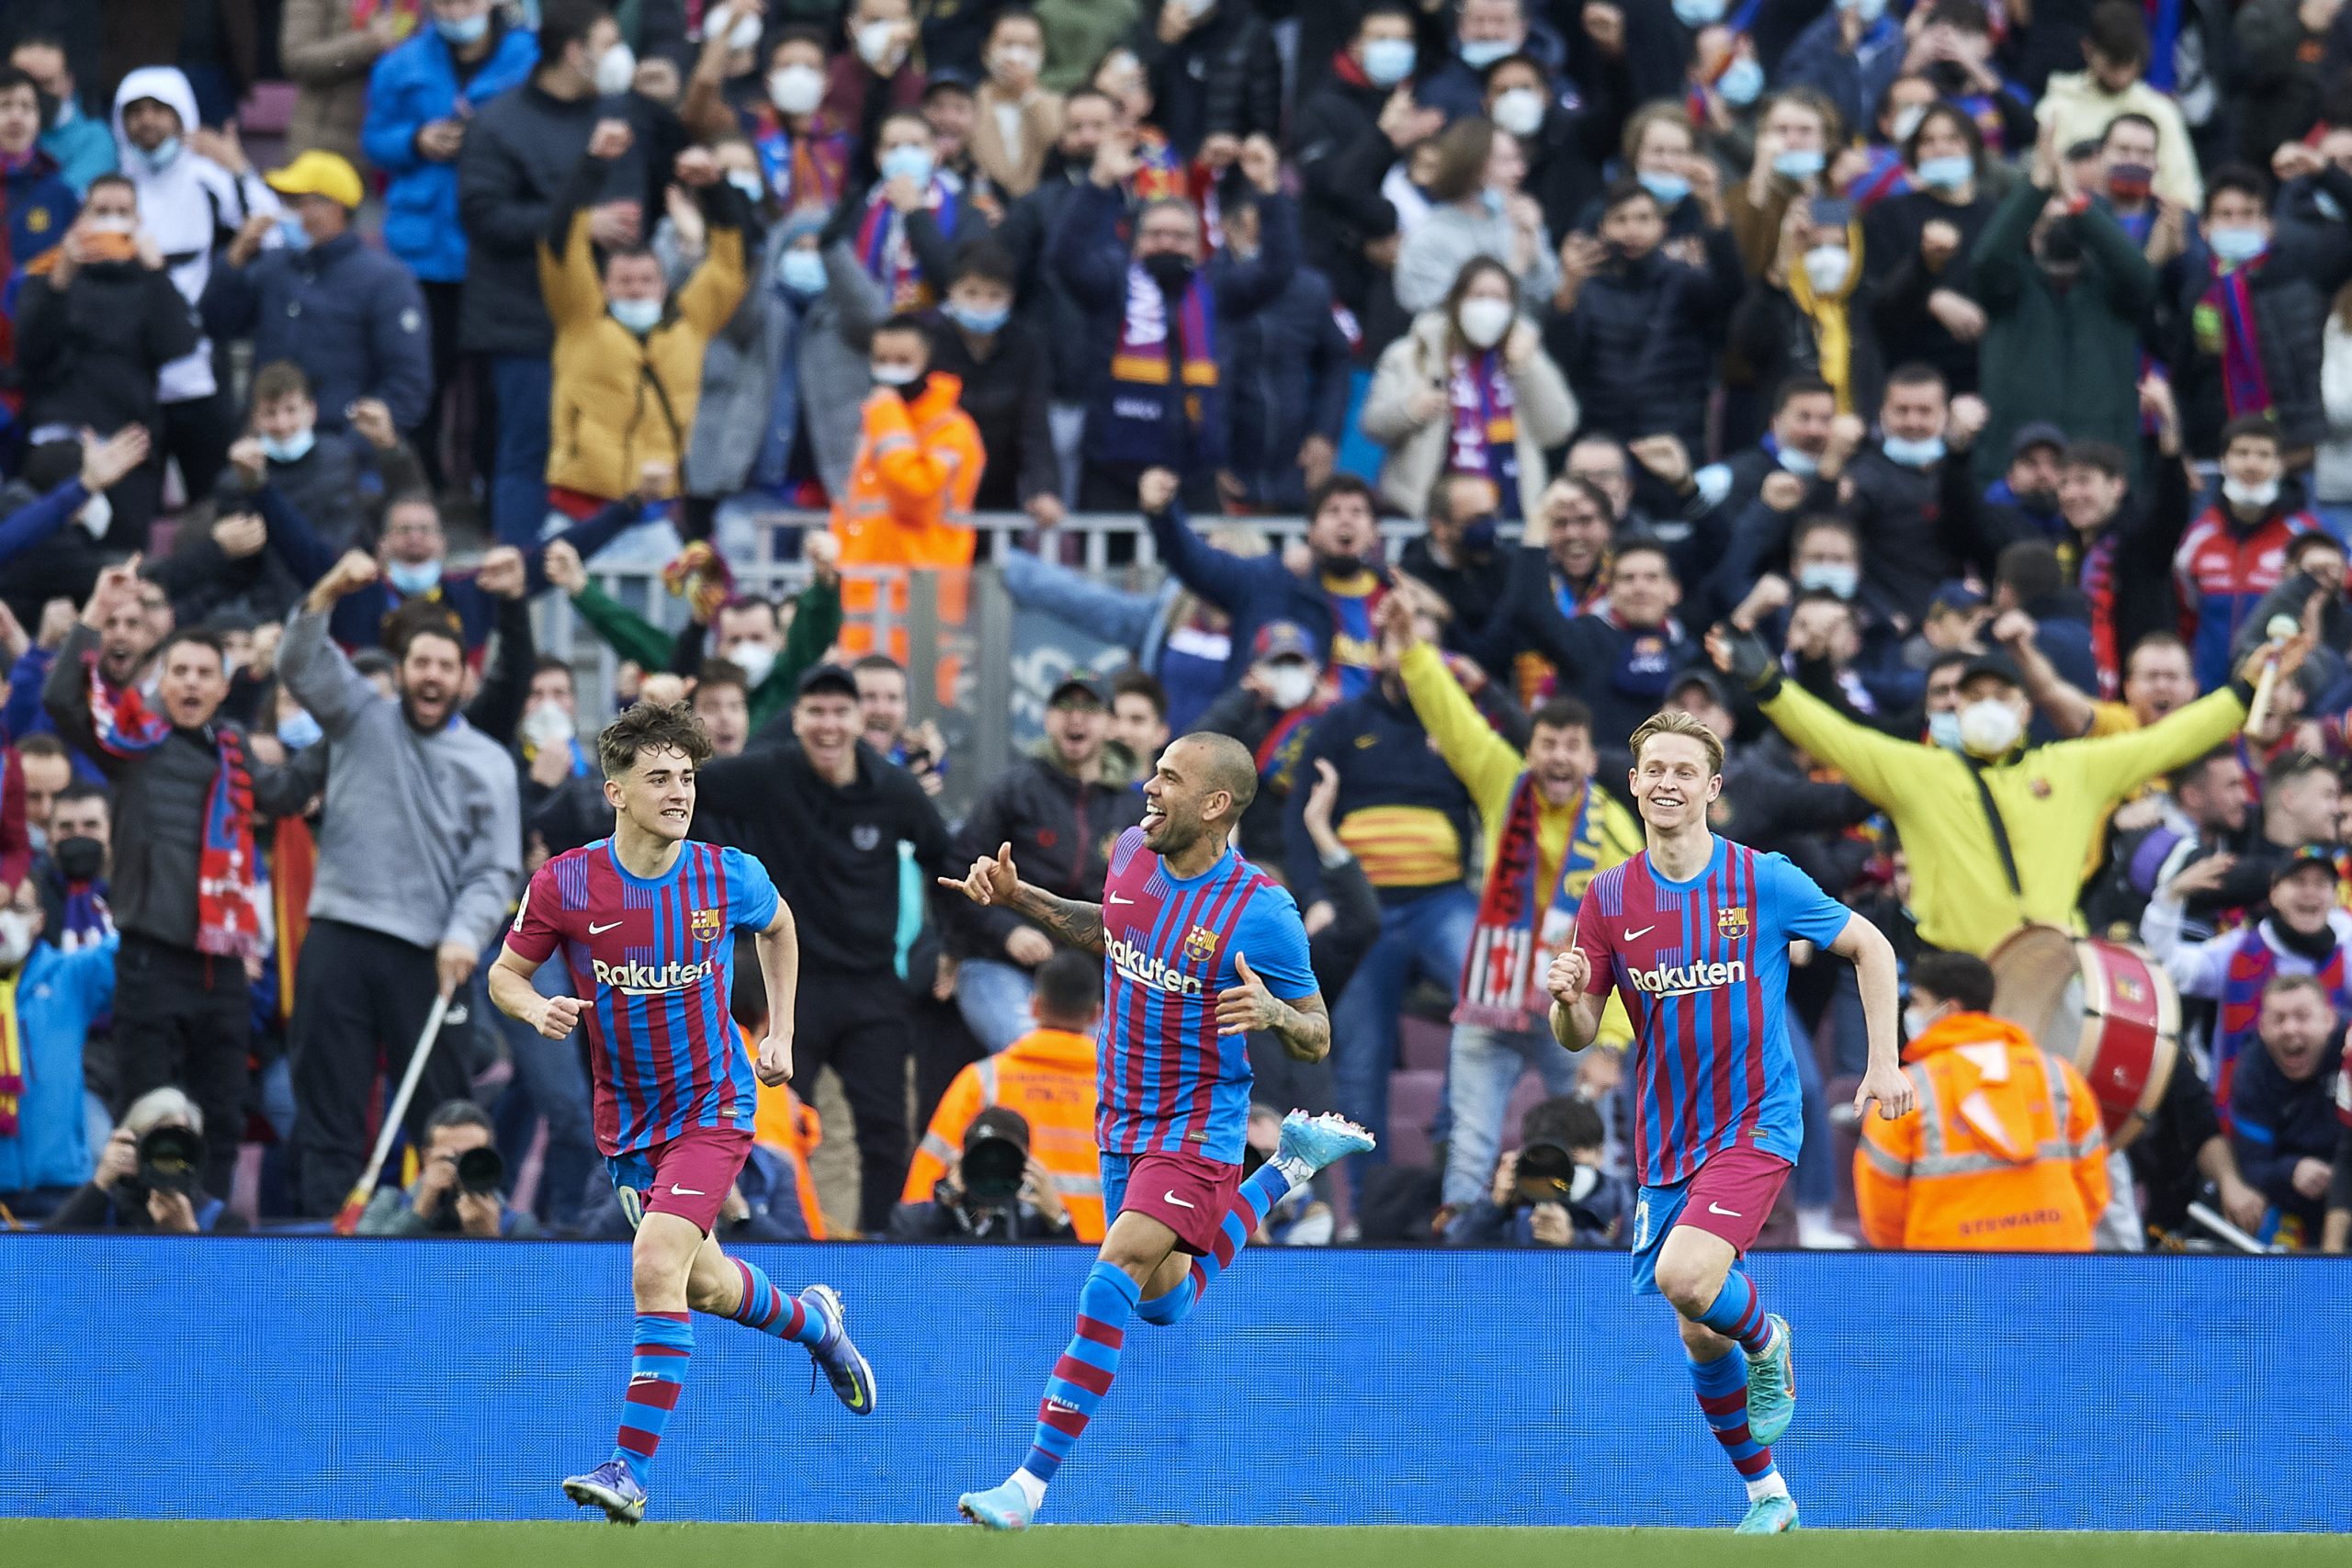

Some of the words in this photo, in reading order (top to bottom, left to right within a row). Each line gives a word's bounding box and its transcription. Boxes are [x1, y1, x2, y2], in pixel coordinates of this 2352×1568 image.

[593, 959, 713, 988] Rakuten
[1103, 926, 1202, 994] Rakuten
[1627, 959, 1746, 992] Rakuten
[1959, 1209, 2061, 1237] STEWARD
